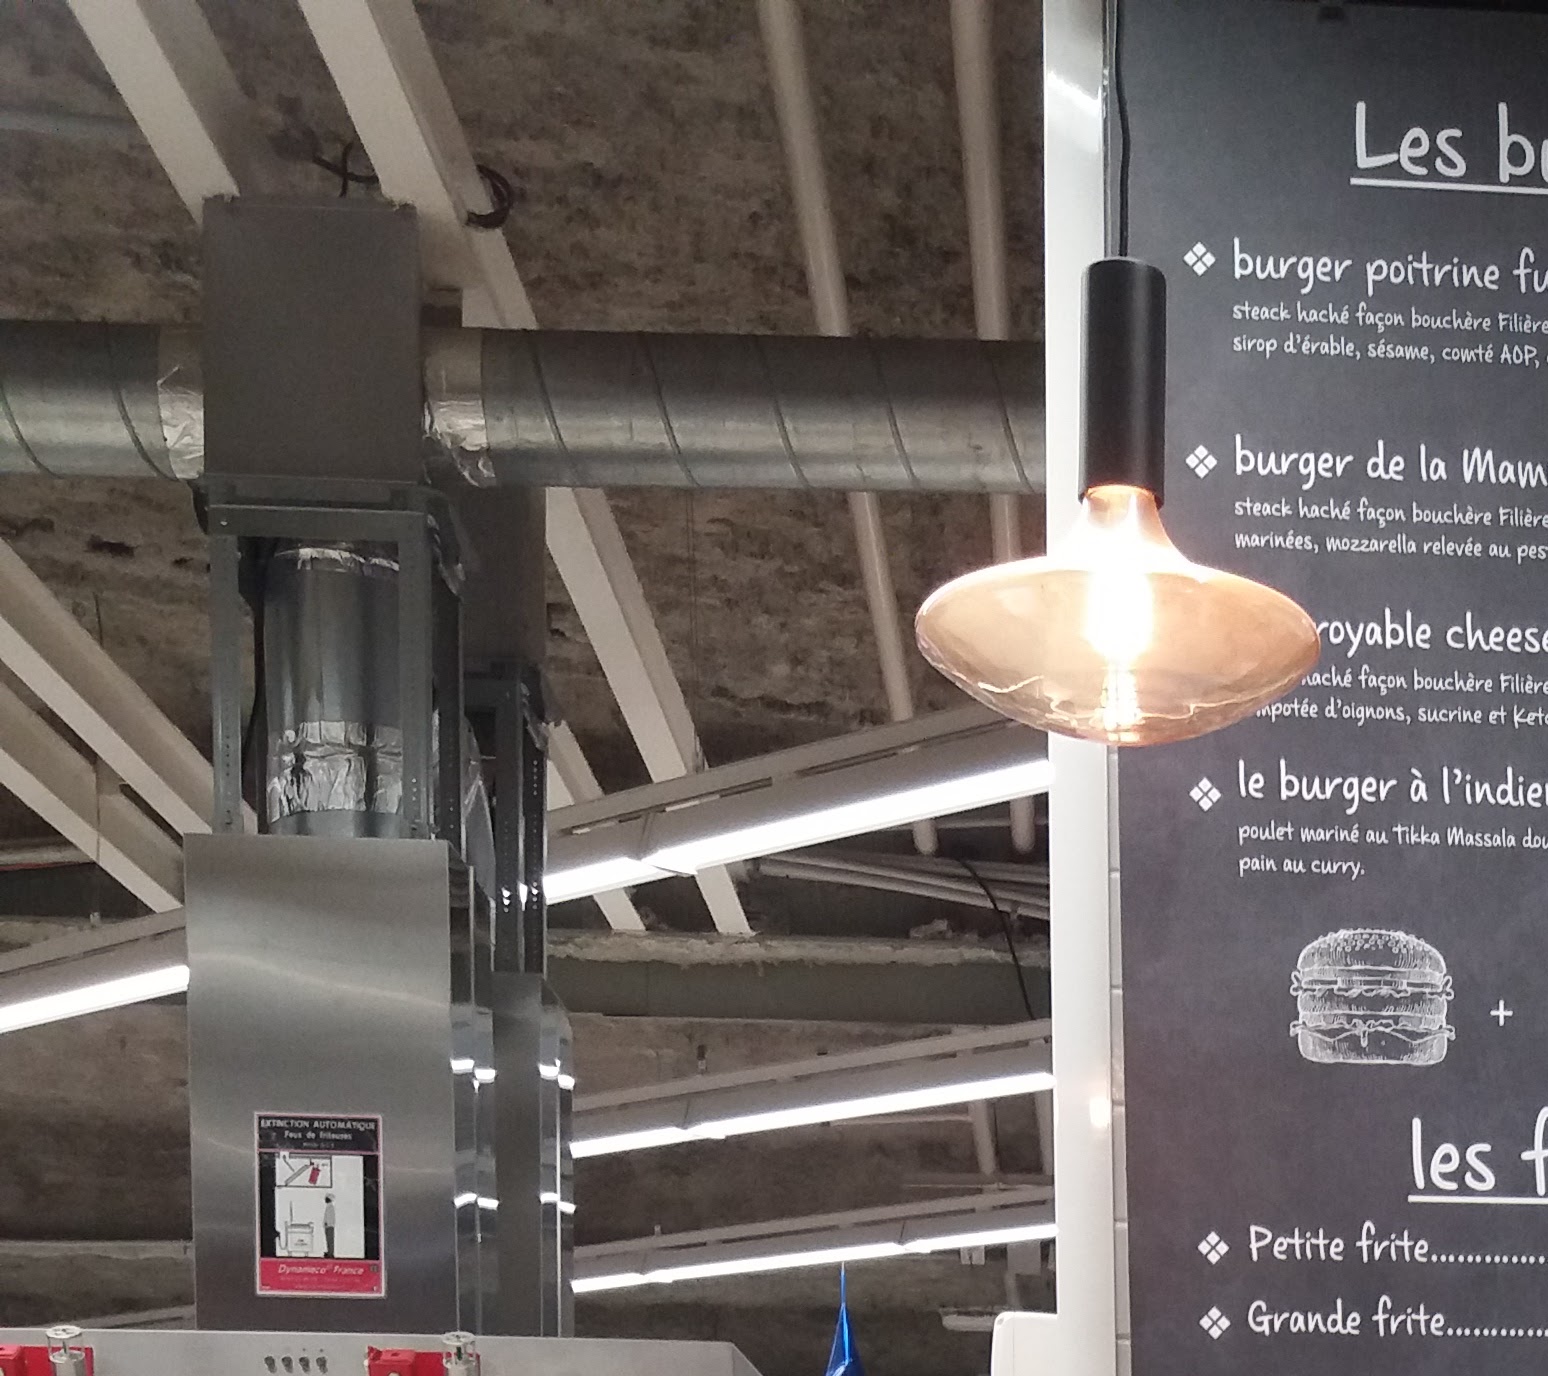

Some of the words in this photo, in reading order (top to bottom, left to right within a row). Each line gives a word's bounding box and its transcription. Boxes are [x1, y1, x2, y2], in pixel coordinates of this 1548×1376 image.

[1355, 102, 1466, 181] Les
[1234, 237, 1352, 294] burger
[1366, 251, 1499, 297] poitrine
[1233, 301, 1291, 321] steack
[1297, 301, 1349, 324] haché
[1355, 302, 1404, 333] façon
[1412, 307, 1491, 331] bouchère
[1498, 313, 1548, 334] Filière
[1234, 335, 1277, 359] sirop
[1284, 332, 1360, 360] d'érable,
[1368, 339, 1434, 364] sésame,
[1442, 344, 1493, 363] comté
[1500, 344, 1539, 368] AOP,
[1236, 434, 1354, 490] burger
[1367, 439, 1404, 481] de
[1420, 443, 1447, 481] la
[1235, 497, 1292, 517] steack
[1299, 497, 1350, 520] haché
[1357, 497, 1406, 528] façon
[1413, 502, 1491, 525] bouchère
[1235, 530, 1318, 553] marinées,
[1326, 533, 1416, 553] mozzarella
[1424, 535, 1482, 556] relevée
[1489, 544, 1511, 557] au
[1316, 607, 1431, 658] royable
[1358, 664, 1407, 695] façon
[1414, 668, 1492, 692] bouchère
[1325, 697, 1411, 726] d'oignons,
[1418, 706, 1482, 723] sucrine
[1489, 705, 1507, 724] et
[1239, 759, 1264, 798] le
[1280, 758, 1397, 815] burger
[1410, 768, 1428, 802] à
[1239, 820, 1294, 845] poulet
[1301, 824, 1359, 843] mariné
[1366, 830, 1388, 844] au
[1392, 824, 1440, 845] Tikka
[1447, 827, 1516, 847] Massala
[1239, 855, 1277, 877] pain
[1283, 859, 1306, 873] au
[1311, 858, 1365, 880] curry.
[1409, 1116, 1495, 1193] les
[1250, 1225, 1344, 1262] Petite
[1356, 1220, 1430, 1265] frite
[1248, 1298, 1361, 1336] Grande
[1372, 1295, 1446, 1339] frite
